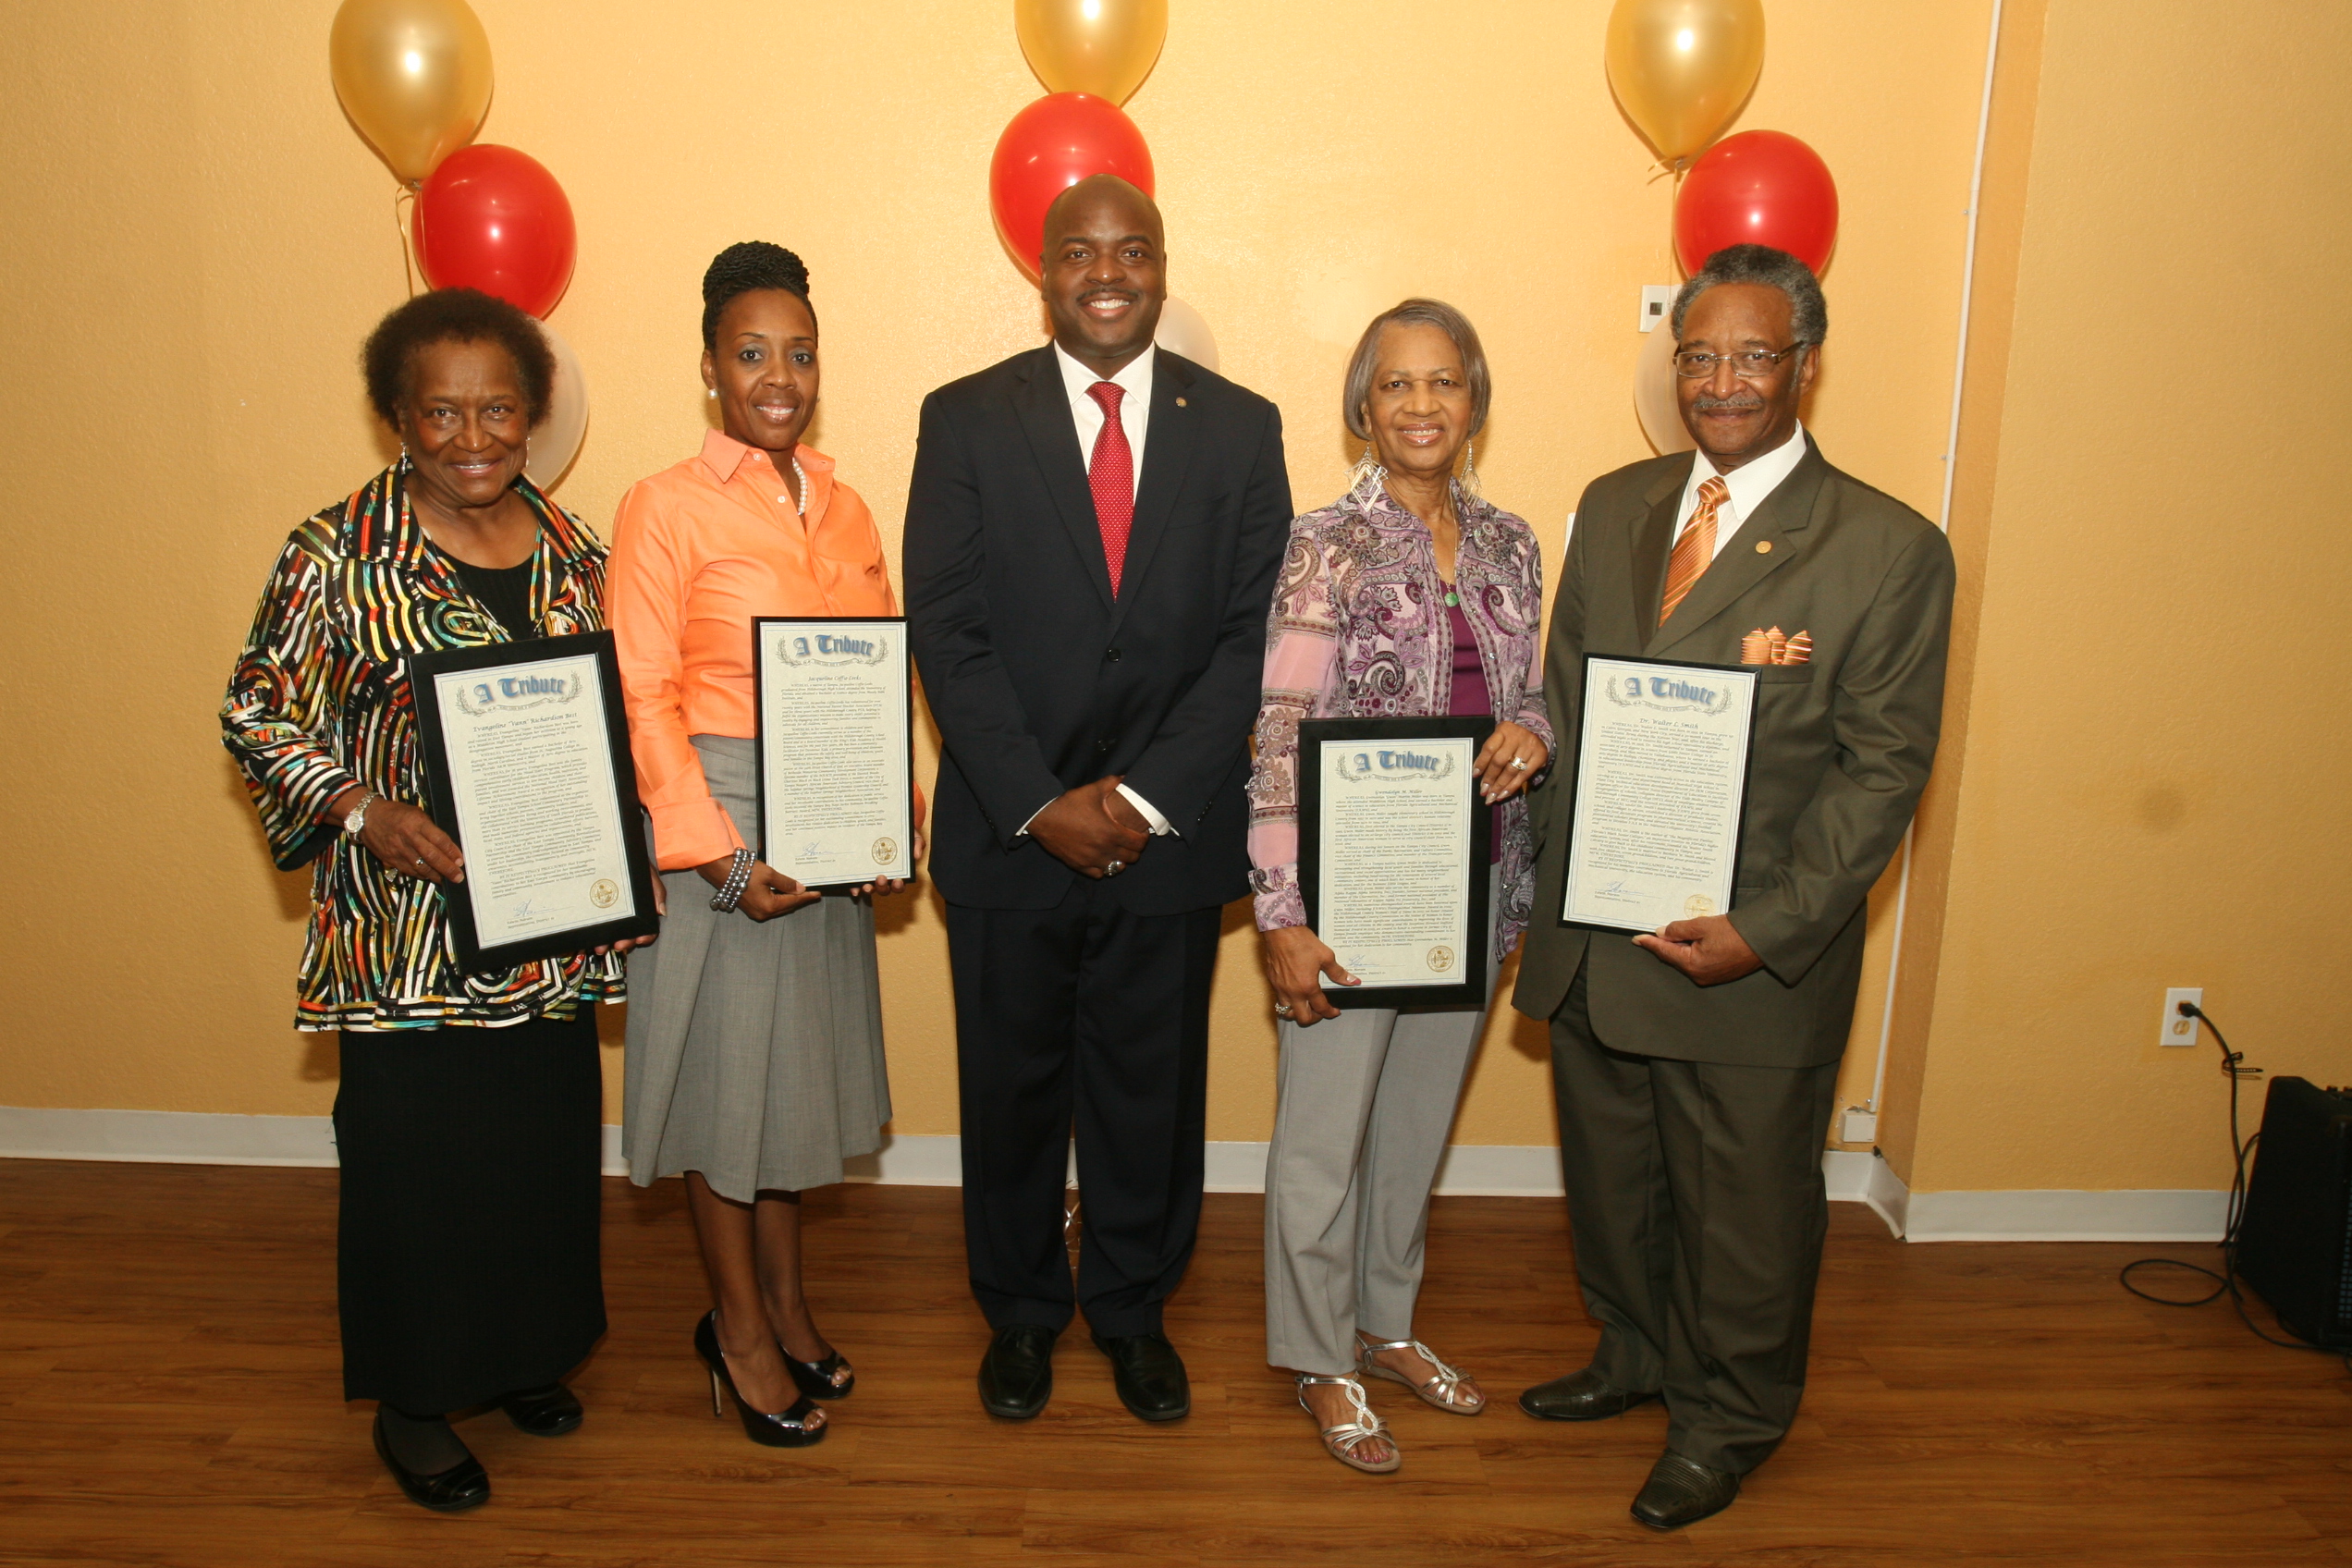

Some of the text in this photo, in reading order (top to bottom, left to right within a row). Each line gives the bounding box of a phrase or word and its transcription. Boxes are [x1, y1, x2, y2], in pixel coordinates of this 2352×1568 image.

[793, 634, 875, 656] A Tribute
[473, 682, 495, 704] A
[497, 675, 566, 698] Tribute
[1623, 676, 1716, 705] A Tribute
[1354, 750, 1439, 772] A Tribute
